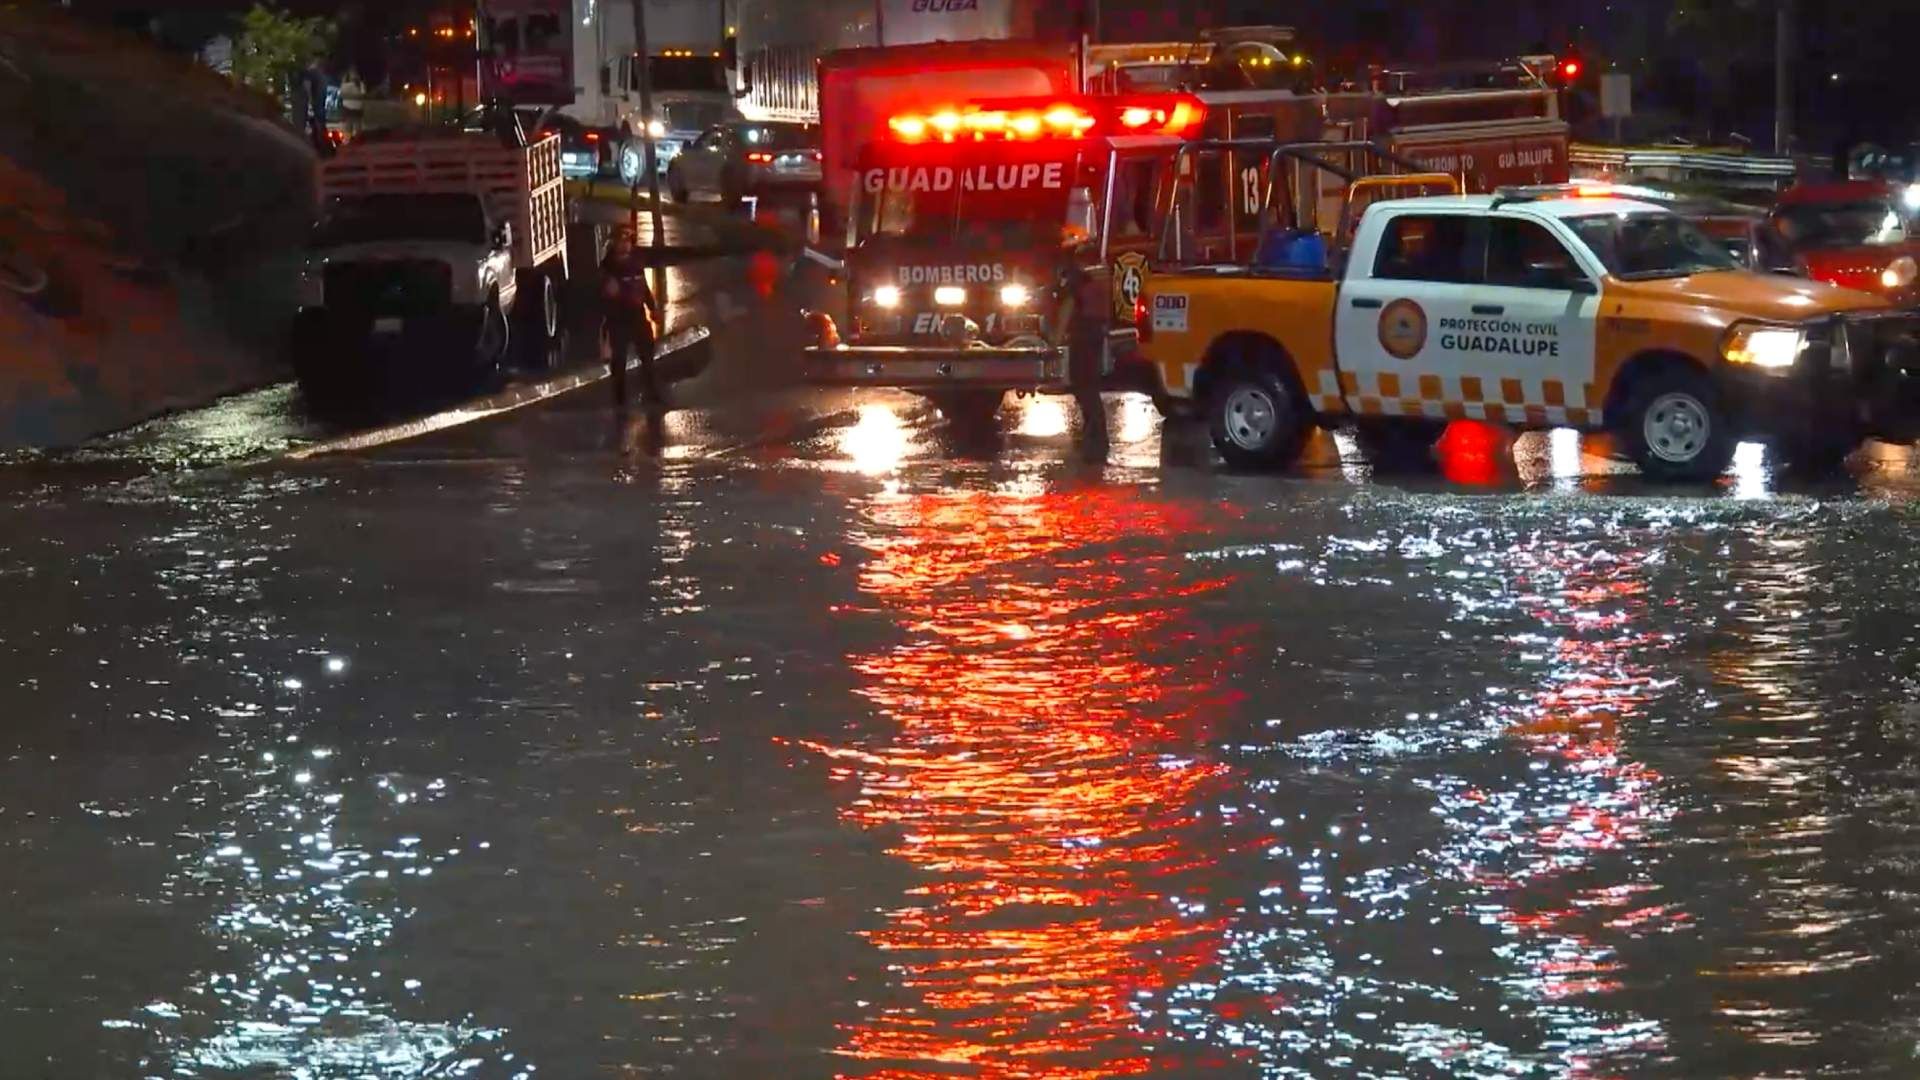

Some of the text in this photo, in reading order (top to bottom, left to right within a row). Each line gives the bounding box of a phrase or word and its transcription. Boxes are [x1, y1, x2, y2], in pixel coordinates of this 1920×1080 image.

[1498, 148, 1554, 168] GUADALUPE
[863, 163, 1063, 193] GUADALUPE
[1241, 167, 1259, 214] 13
[899, 263, 1004, 283] BOMBEROS
[1526, 323, 1559, 336] CIVIL
[1440, 335, 1559, 357] GUADALUPE
